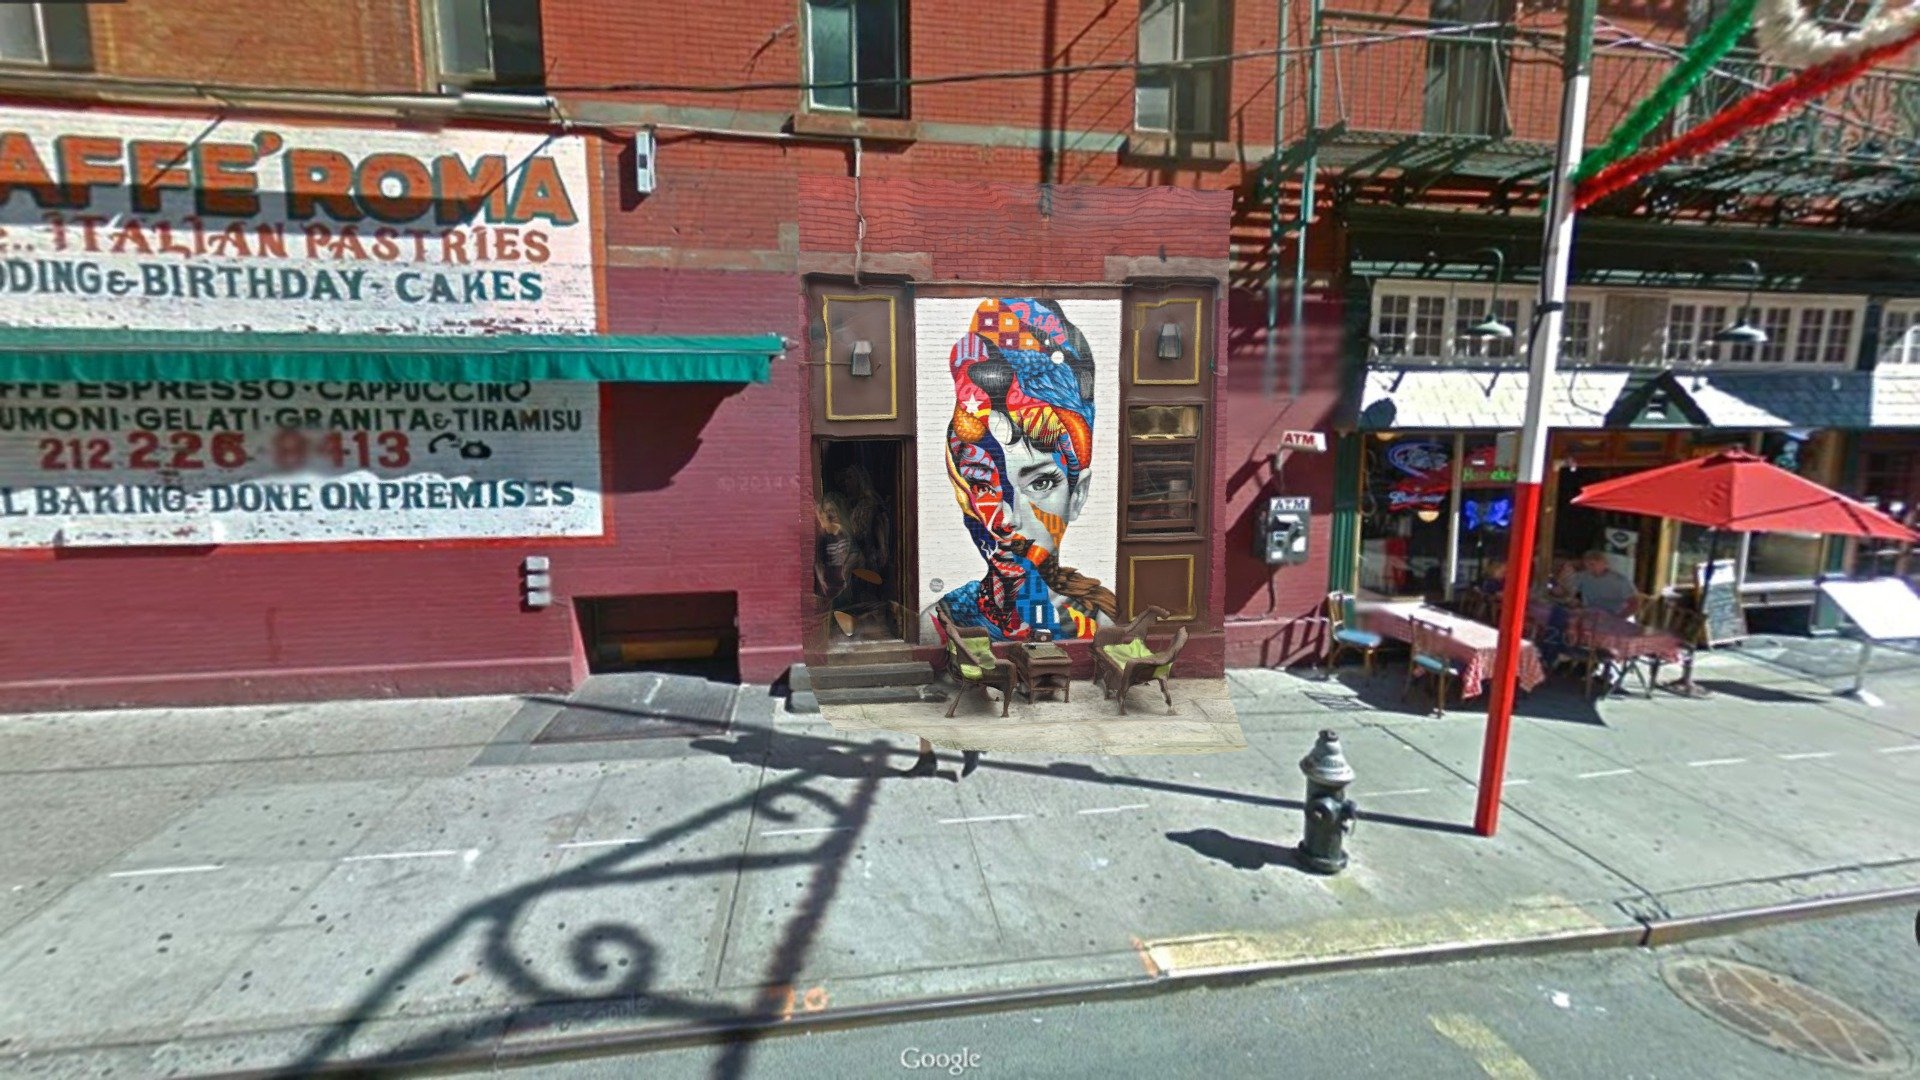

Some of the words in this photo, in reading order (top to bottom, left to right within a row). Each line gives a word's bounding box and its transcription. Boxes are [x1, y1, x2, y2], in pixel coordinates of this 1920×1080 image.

[282, 148, 578, 227] ROMA
[41, 211, 289, 261] ITALIAN
[304, 223, 551, 264] PASTRIES
[0, 258, 102, 294] DING
[394, 271, 543, 302] CAKES
[78, 382, 295, 400] ESPRESSO
[316, 380, 531, 400] CAPPUCCINO
[135, 407, 260, 431] GELATI
[275, 407, 433, 431] GRANITA
[452, 408, 582, 432] TIRAMISU
[39, 438, 112, 470] 212
[126, 431, 248, 469] 226
[1285, 433, 1315, 445] ATM
[35, 484, 187, 515] BAKING
[209, 481, 313, 512] DONE
[319, 480, 372, 511] ON
[378, 478, 576, 509] PREMISES
